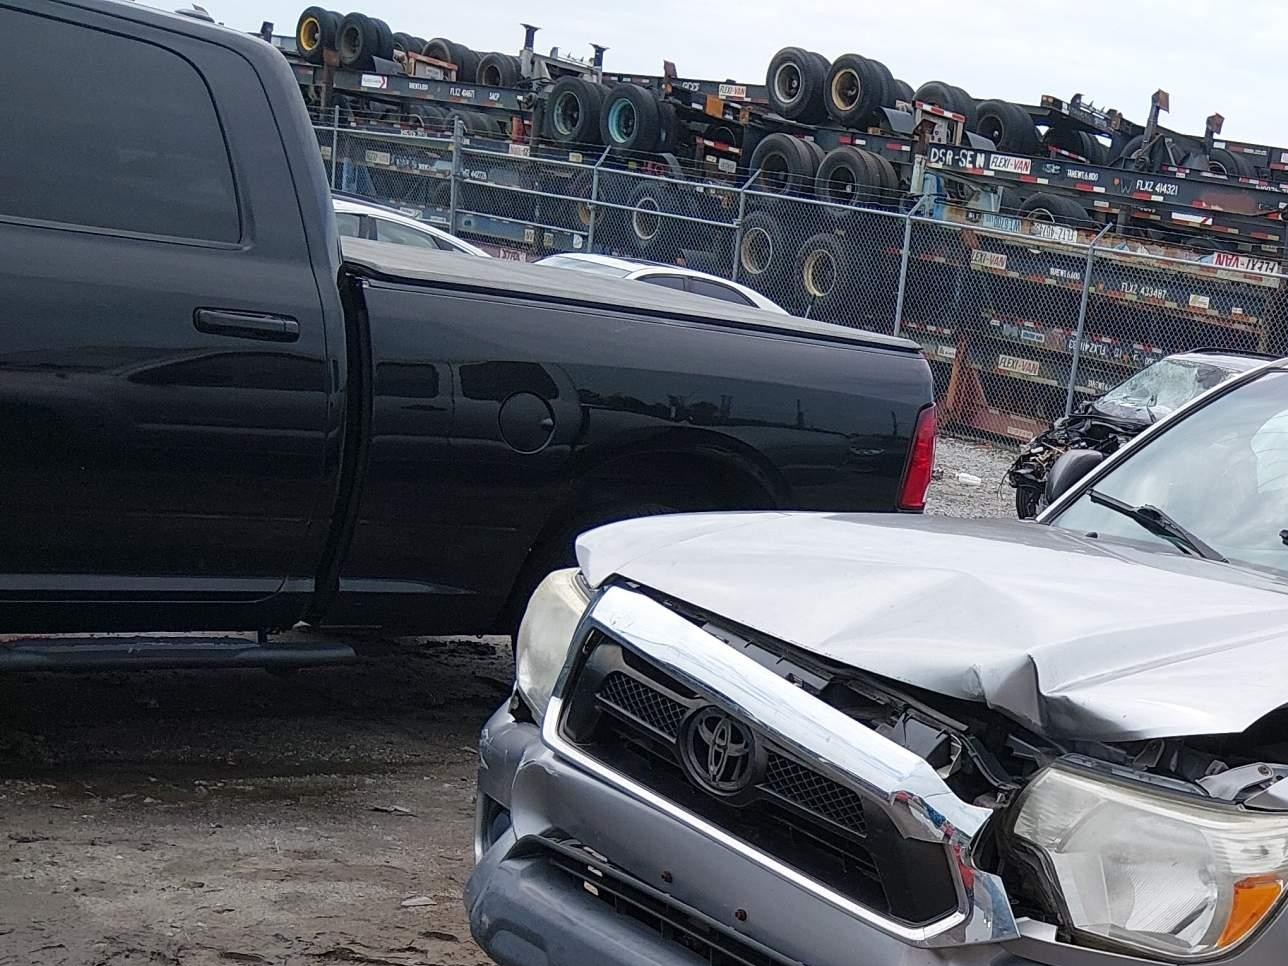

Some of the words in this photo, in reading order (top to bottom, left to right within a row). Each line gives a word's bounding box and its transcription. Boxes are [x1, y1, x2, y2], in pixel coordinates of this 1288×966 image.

[991, 155, 1031, 173] FLEXI-VAN
[1136, 179, 1155, 192] FLXZ
[1155, 182, 1179, 196] 414321
